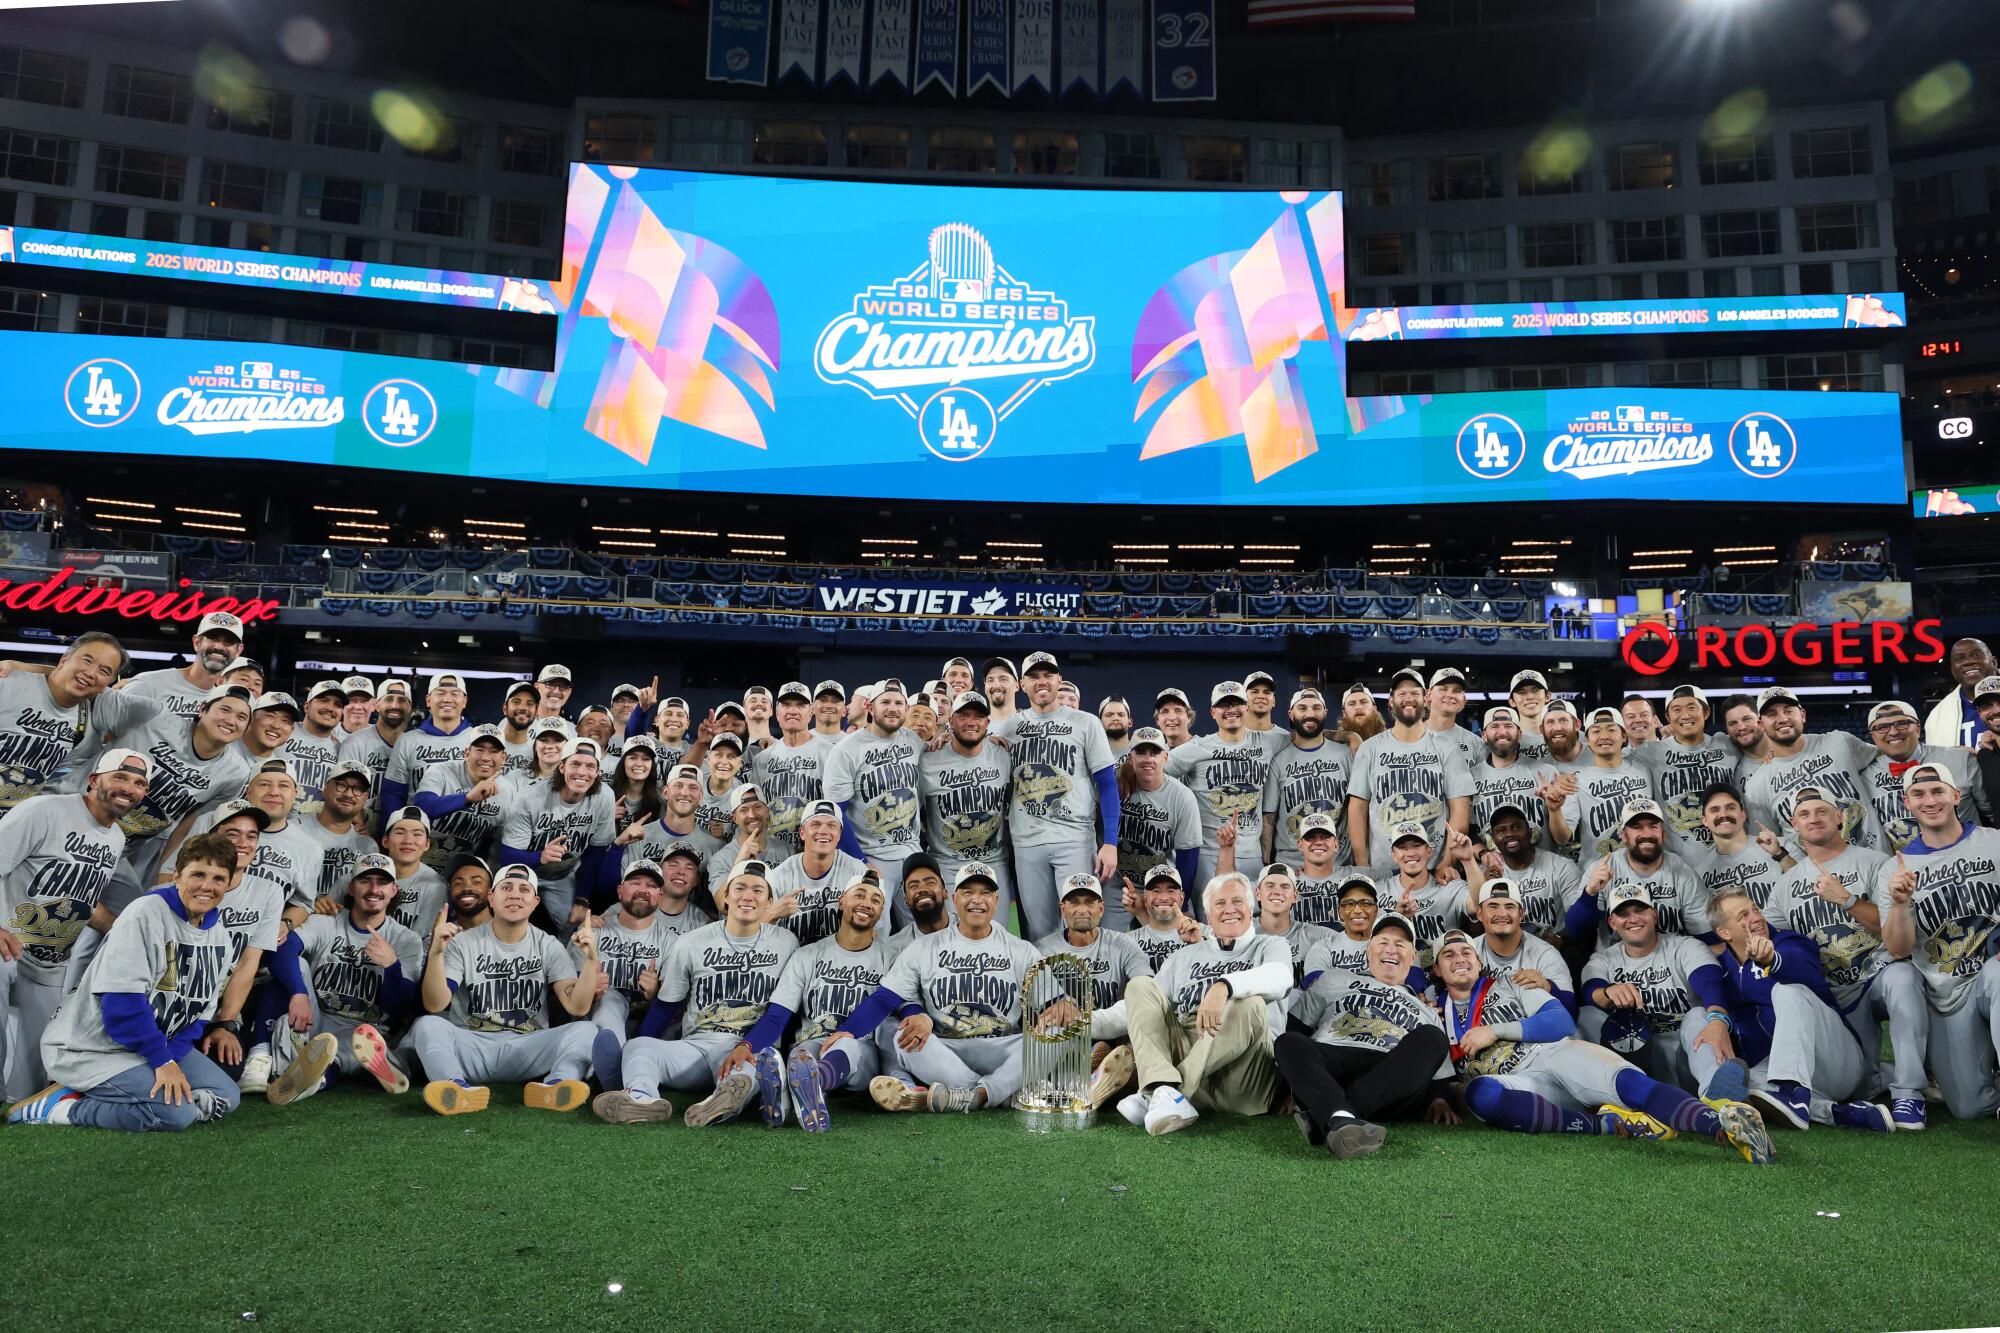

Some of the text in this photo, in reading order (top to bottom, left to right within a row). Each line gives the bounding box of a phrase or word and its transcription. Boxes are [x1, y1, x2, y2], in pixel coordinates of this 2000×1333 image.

[924, 0, 955, 16] 1992
[973, 0, 1004, 17] 1993
[1018, 2, 1050, 20] 2015
[1064, 3, 1096, 20] 2016
[784, 27, 814, 43] EAST
[923, 19, 955, 32] WORLD
[973, 21, 1005, 33] WORLD
[1157, 12, 1211, 48] 32
[831, 32, 859, 47] EAST
[875, 35, 906, 49] EAST
[922, 34, 953, 46] SERIES
[972, 37, 1004, 50] SERIES
[920, 49, 954, 63] CHAMPS
[972, 51, 1006, 65] CHAMPS
[22, 242, 495, 299] CONGRATULATIONS 2025 WORLD SERIES CHAMPIONS LOS ANGELES DODGERS
[900, 285, 1023, 301] 20 25
[863, 301, 1059, 321] WORLD SERIES
[1407, 307, 1839, 330] CONGRATULATIONS 2025 WORLD SERIES CHAMPIONS LOS ANGELES DODGERS
[821, 317, 1090, 388] Champions
[214, 365, 301, 380] 20 25
[84, 366, 122, 416] LA
[188, 375, 326, 395] WORLD SERIES
[156, 387, 345, 435] Champions
[381, 387, 419, 437] LA
[1591, 411, 1669, 421] 20 25
[939, 396, 978, 449] LA
[1567, 421, 1693, 434] WORLD SERIES
[1942, 421, 1969, 437] CC
[1473, 422, 1509, 468] LA
[1745, 420, 1781, 467] LA
[1543, 433, 1713, 480] Champions
[104, 555, 159, 565] HOME RUN ZONE
[0, 566, 280, 625] dweiser
[819, 586, 1081, 614] WESTJET FLIGHT
[1697, 618, 1946, 668] ROGERS
[1016, 719, 1073, 738] World Series
[286, 739, 318, 758] World
[417, 745, 450, 763] World
[864, 744, 914, 766] World Series
[1212, 747, 1263, 761] World Series
[1697, 748, 1725, 768] Series
[768, 755, 798, 774] World
[1285, 759, 1340, 779] World Series
[1379, 752, 1439, 772] World Series
[860, 763, 919, 804] CHAMPIO
[939, 767, 1000, 788] World Series
[1206, 759, 1269, 790] CHAMPIONS
[1770, 753, 1834, 794] World Series
[762, 772, 823, 802] CHAMPIONS
[1283, 775, 1348, 814] CHAMPIONS
[1376, 768, 1444, 804] CHAMPIONS
[1475, 776, 1535, 797] World Series
[1588, 775, 1648, 798] World Series
[1026, 801, 1047, 816] 2025
[1142, 804, 1169, 821] Series
[565, 812, 593, 832] Series
[64, 831, 102, 862] World
[892, 828, 913, 844] 2025
[256, 845, 292, 869] Series
[963, 846, 989, 858] 2025
[1702, 861, 1769, 889] World Series
[1914, 857, 1996, 892] World Series
[1295, 878, 1325, 894] World
[221, 907, 260, 928] Series
[1914, 883, 2000, 937] CHAMPION
[600, 936, 660, 962] World Series
[1331, 950, 1365, 968] World
[475, 954, 541, 981] World Serie
[703, 948, 779, 973] World Series
[815, 959, 854, 982] World
[938, 949, 1011, 976] World Series
[1952, 956, 1984, 978] 2025
[1641, 966, 1672, 989] Series
[696, 970, 779, 1011] CHAMPION
[928, 973, 1017, 1017] CHAMPIONS
[1385, 988, 1420, 1015] Series
